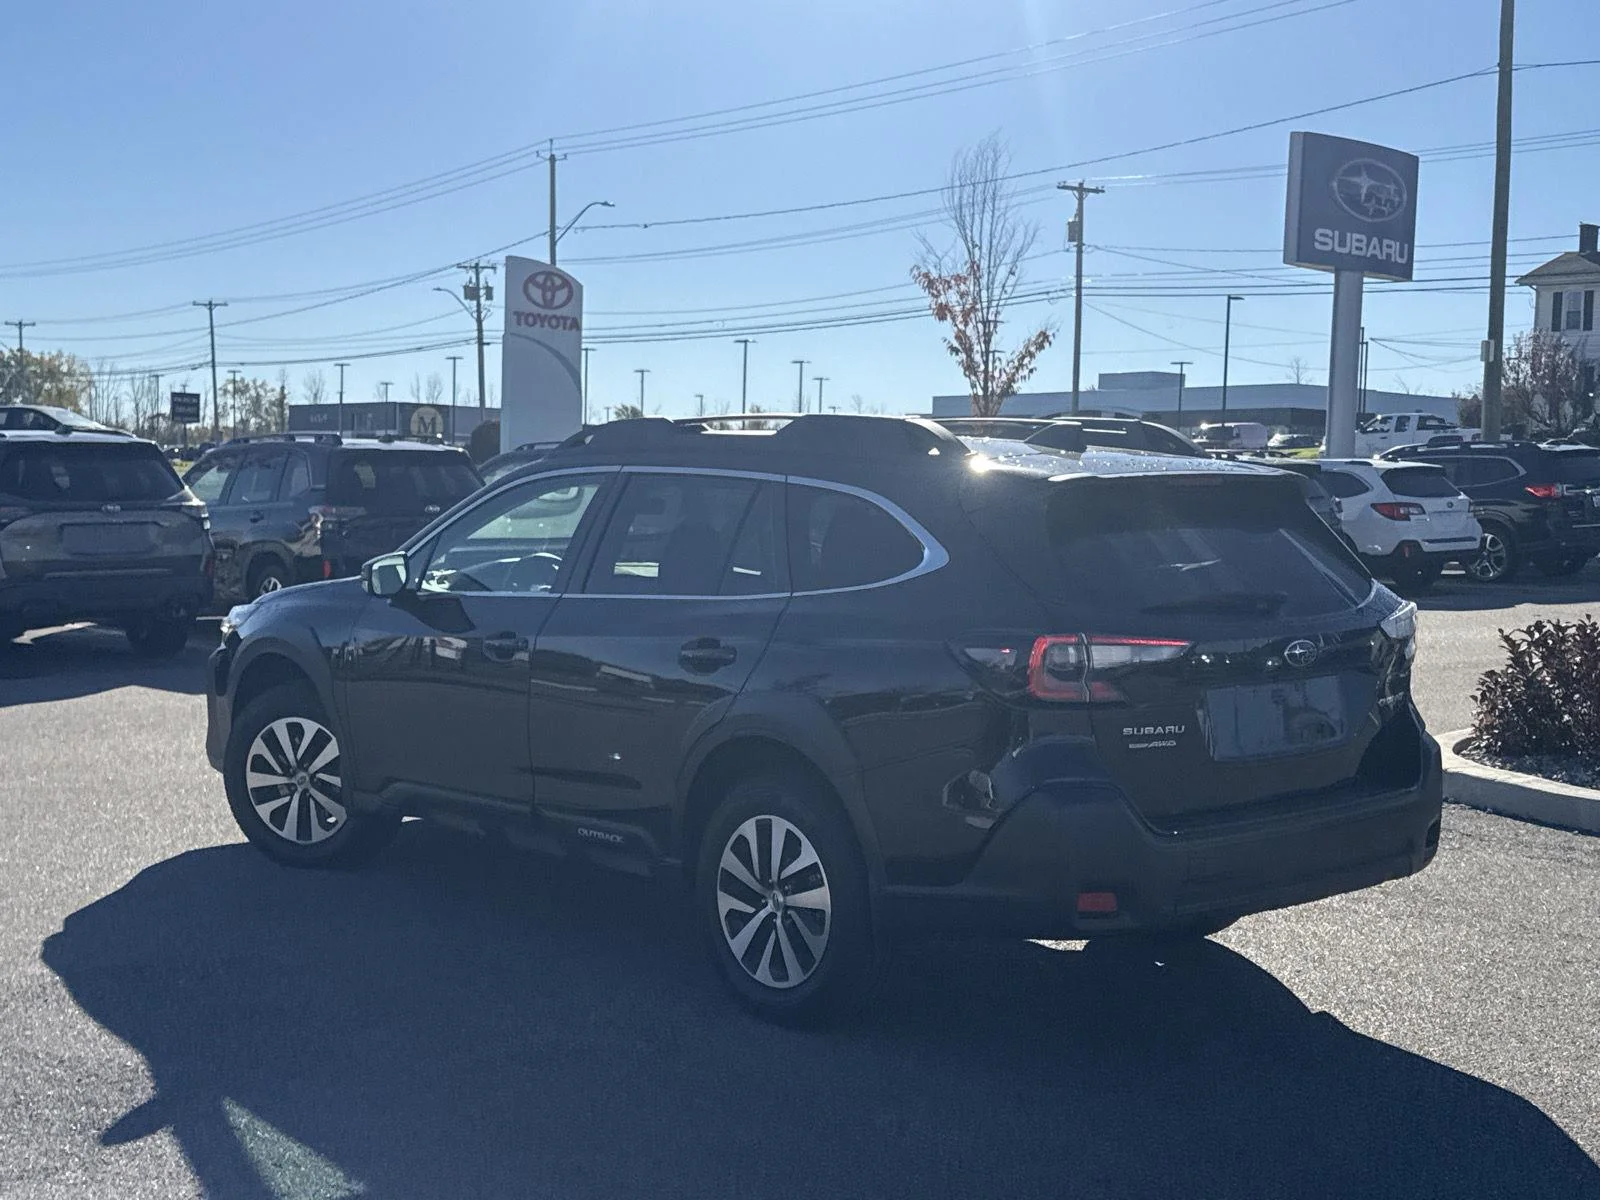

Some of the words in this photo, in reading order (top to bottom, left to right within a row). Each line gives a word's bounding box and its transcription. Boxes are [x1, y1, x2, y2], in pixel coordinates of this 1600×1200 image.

[1314, 228, 1408, 264] SUBARU
[513, 311, 580, 331] TOYOTA
[1122, 725, 1185, 735] SUBARU
